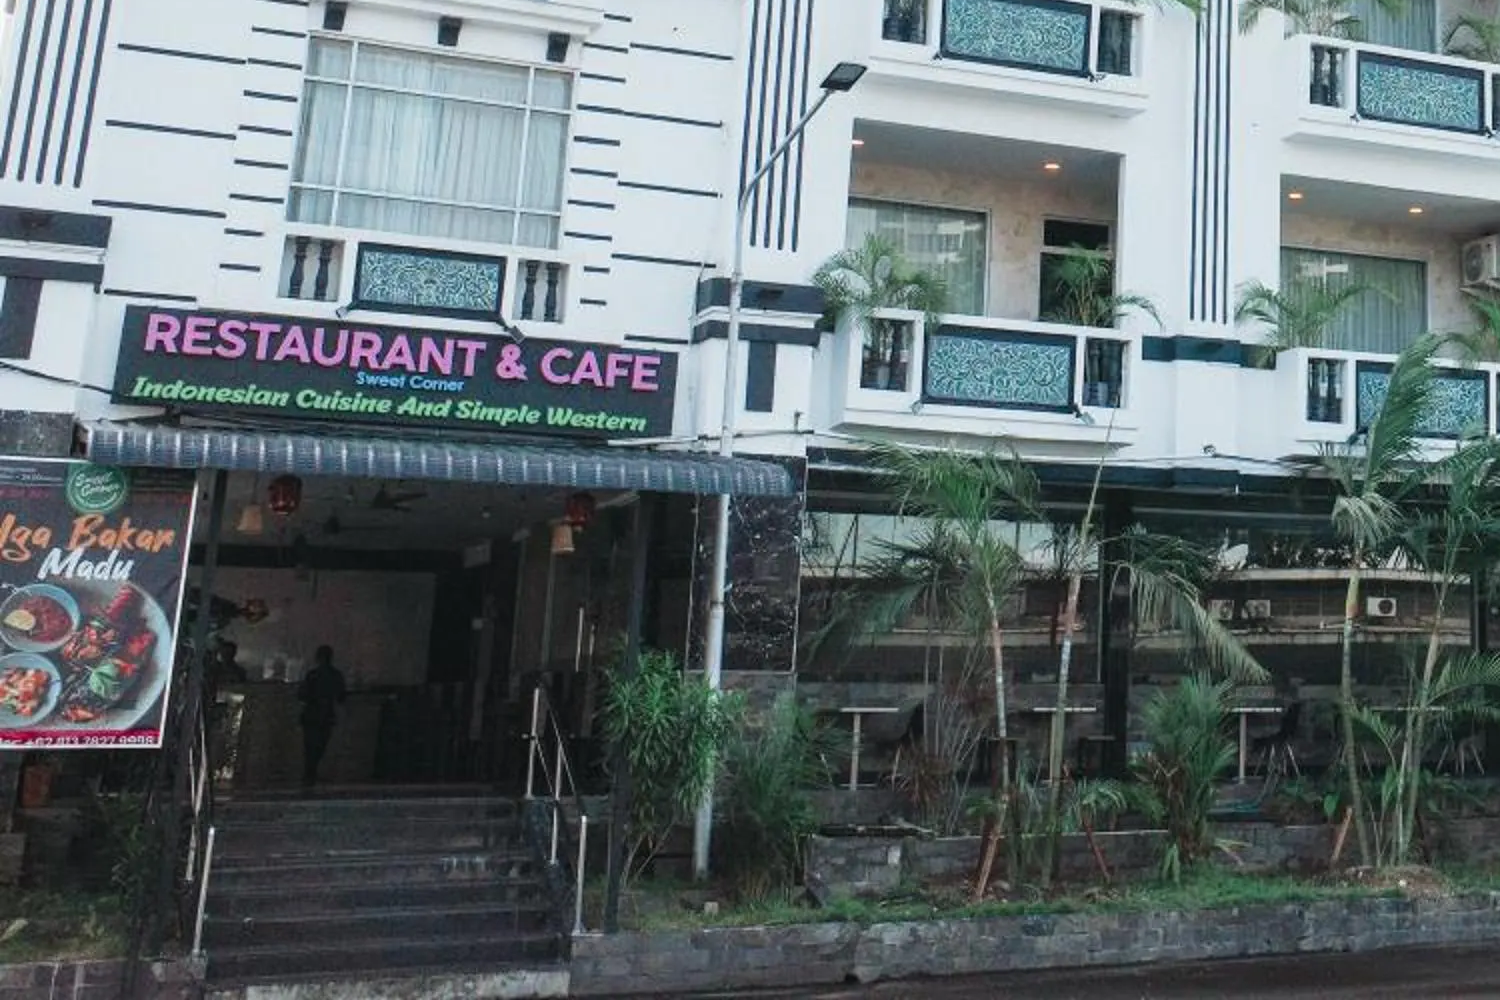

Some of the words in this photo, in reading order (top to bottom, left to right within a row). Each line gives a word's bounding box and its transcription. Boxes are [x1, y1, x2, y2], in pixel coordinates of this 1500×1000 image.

[144, 313, 487, 378] RESTAURANT
[496, 343, 528, 381] &
[540, 347, 661, 391] CAFE
[356, 371, 405, 388] Sweet
[409, 375, 464, 392] Corner
[131, 376, 289, 407] Indonesian
[296, 388, 392, 413] Cuisine
[397, 396, 451, 417] And
[455, 401, 541, 427] Simple
[547, 407, 647, 432] Western
[65, 513, 175, 552] Bakar
[38, 547, 134, 580] Madu
